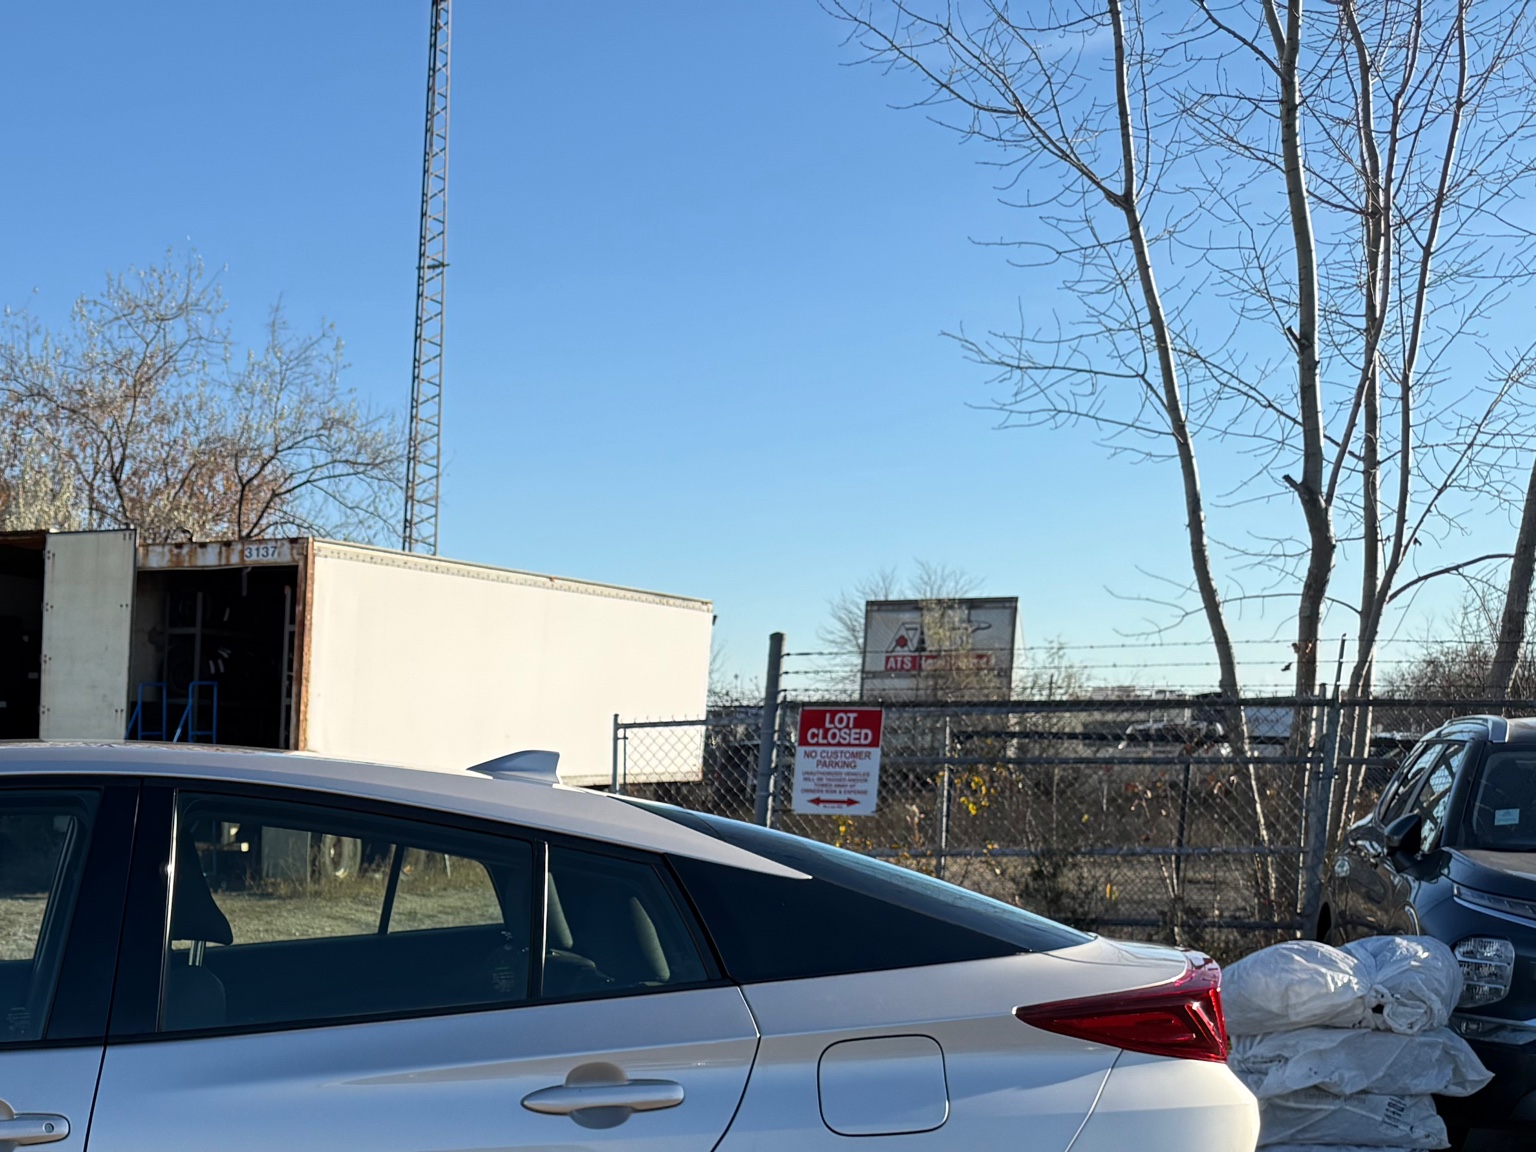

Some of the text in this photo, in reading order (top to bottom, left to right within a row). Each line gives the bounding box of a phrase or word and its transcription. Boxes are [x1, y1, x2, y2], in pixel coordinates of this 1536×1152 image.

[244, 545, 277, 559] 3137
[886, 656, 912, 670] ATS
[825, 712, 858, 728] LOT
[806, 728, 872, 744] CLOSED
[804, 750, 871, 760] NO CUSTOMER
[816, 760, 857, 769] PARKING
